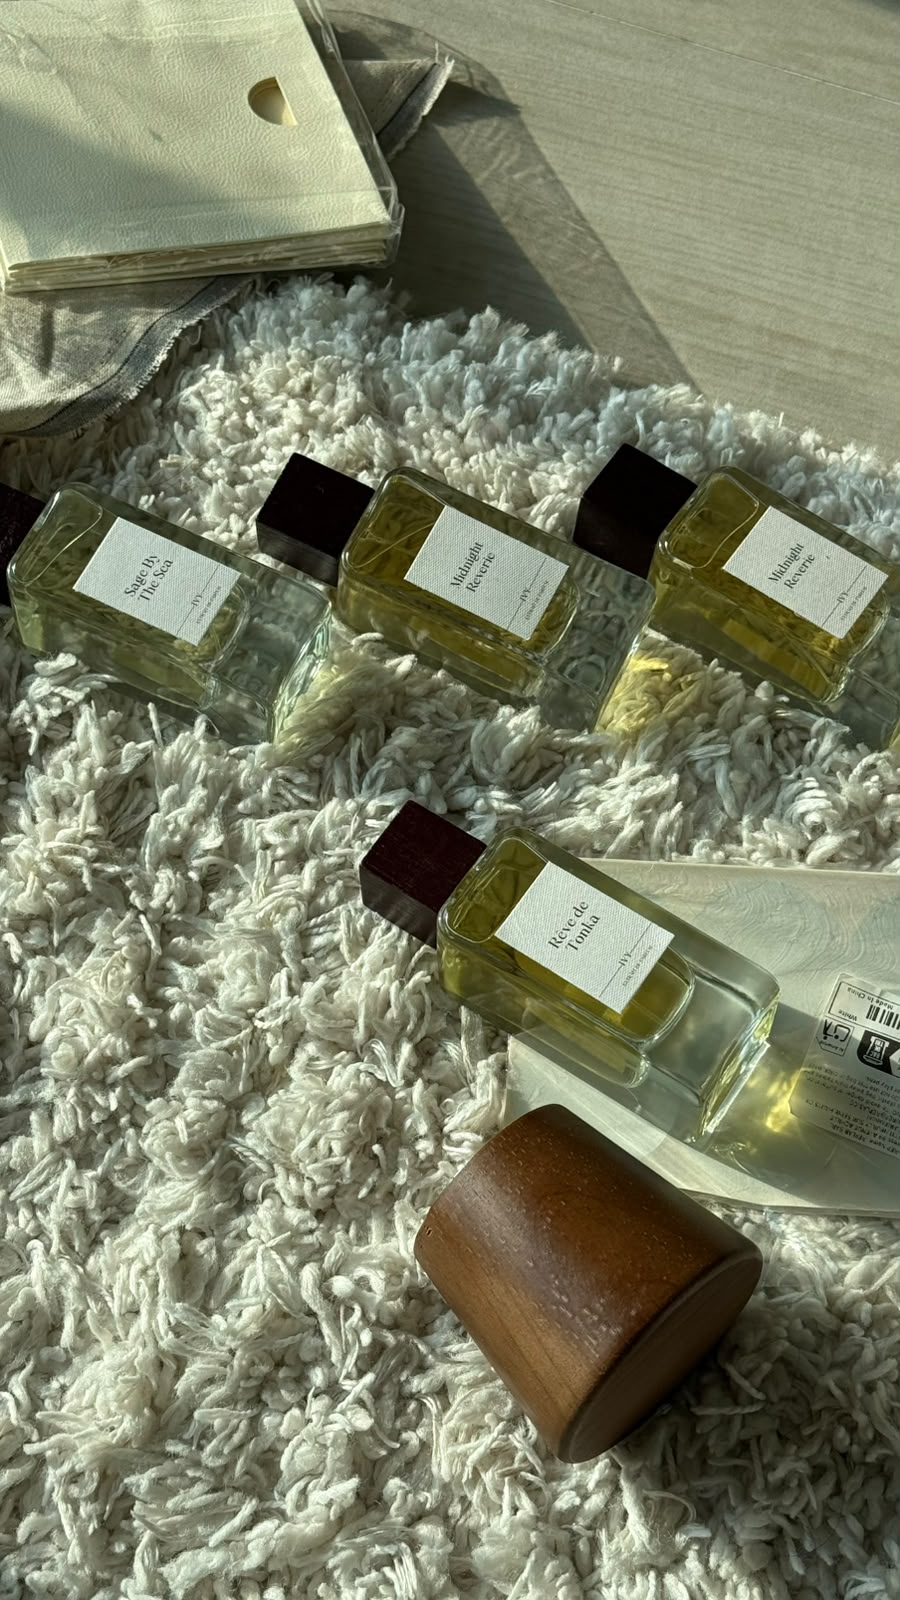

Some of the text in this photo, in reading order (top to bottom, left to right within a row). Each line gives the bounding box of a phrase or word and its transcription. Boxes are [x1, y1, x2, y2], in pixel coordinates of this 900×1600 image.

[450, 542, 484, 589] Midnight
[768, 543, 804, 584] Midnight
[783, 554, 816, 589] Reverie
[124, 555, 160, 598] Sage By
[137, 560, 173, 601] The Sea
[466, 552, 496, 593] Reverie
[190, 592, 203, 607] IVY
[519, 586, 531, 602] IVY
[836, 591, 848, 604] IVY
[572, 901, 589, 918] de
[564, 915, 601, 951] Tonka
[618, 951, 632, 967] IVY
[847, 986, 867, 999] China
[876, 999, 894, 1010] Made
[838, 1009, 858, 1022] White
